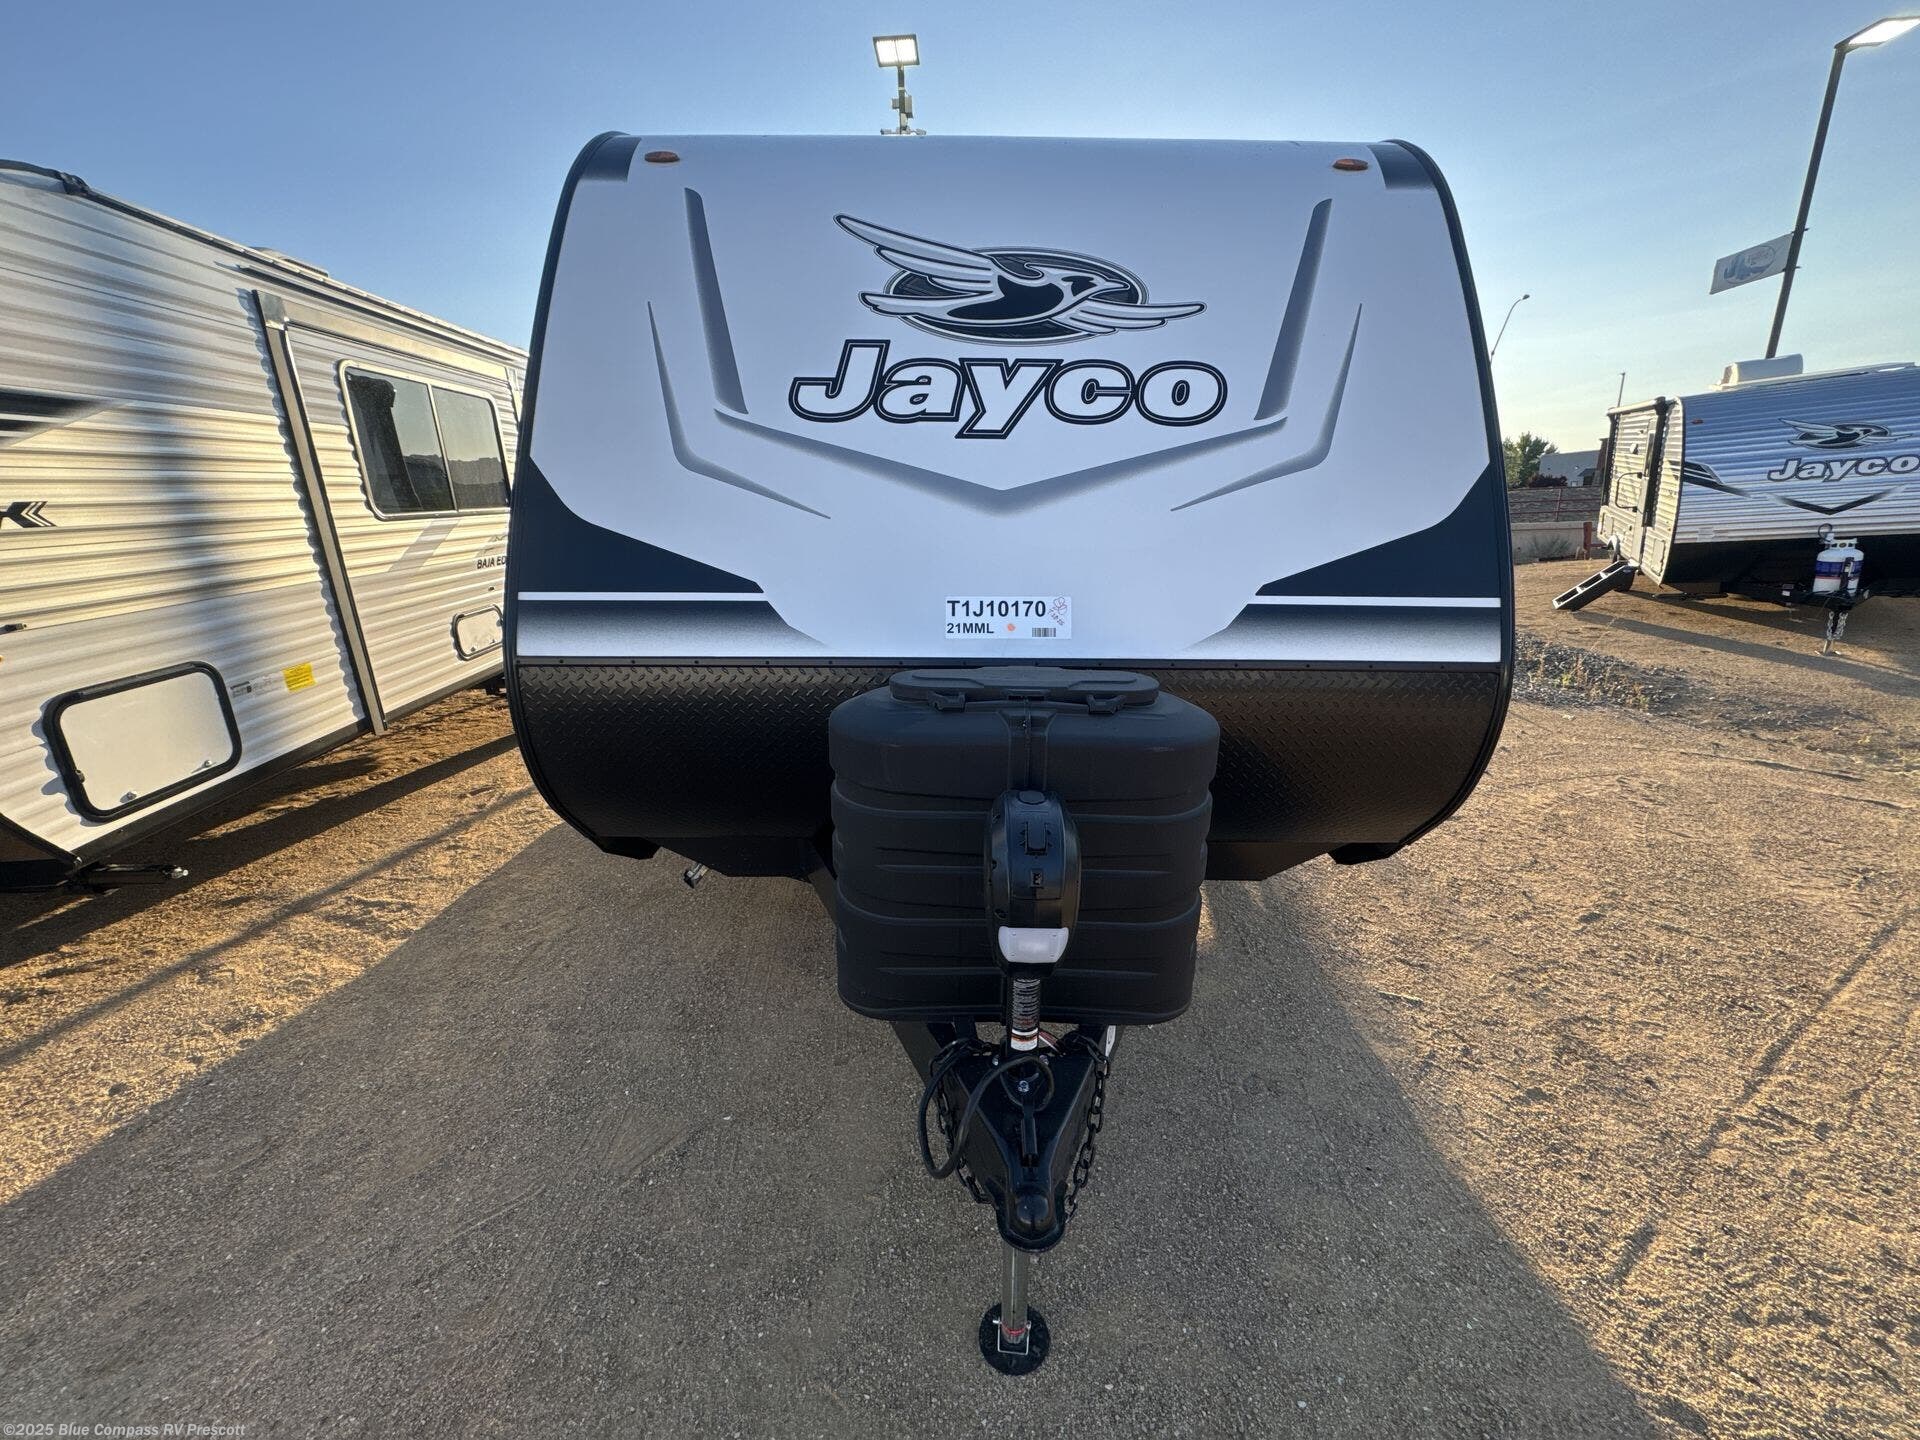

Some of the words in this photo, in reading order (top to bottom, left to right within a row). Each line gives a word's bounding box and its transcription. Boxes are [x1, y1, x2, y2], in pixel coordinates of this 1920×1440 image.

[788, 339, 1228, 439] Jayco
[1767, 454, 1920, 482] Jayco
[477, 557, 495, 569] BAJA
[946, 600, 1046, 617] T1J10170
[946, 622, 994, 634] 21MML
